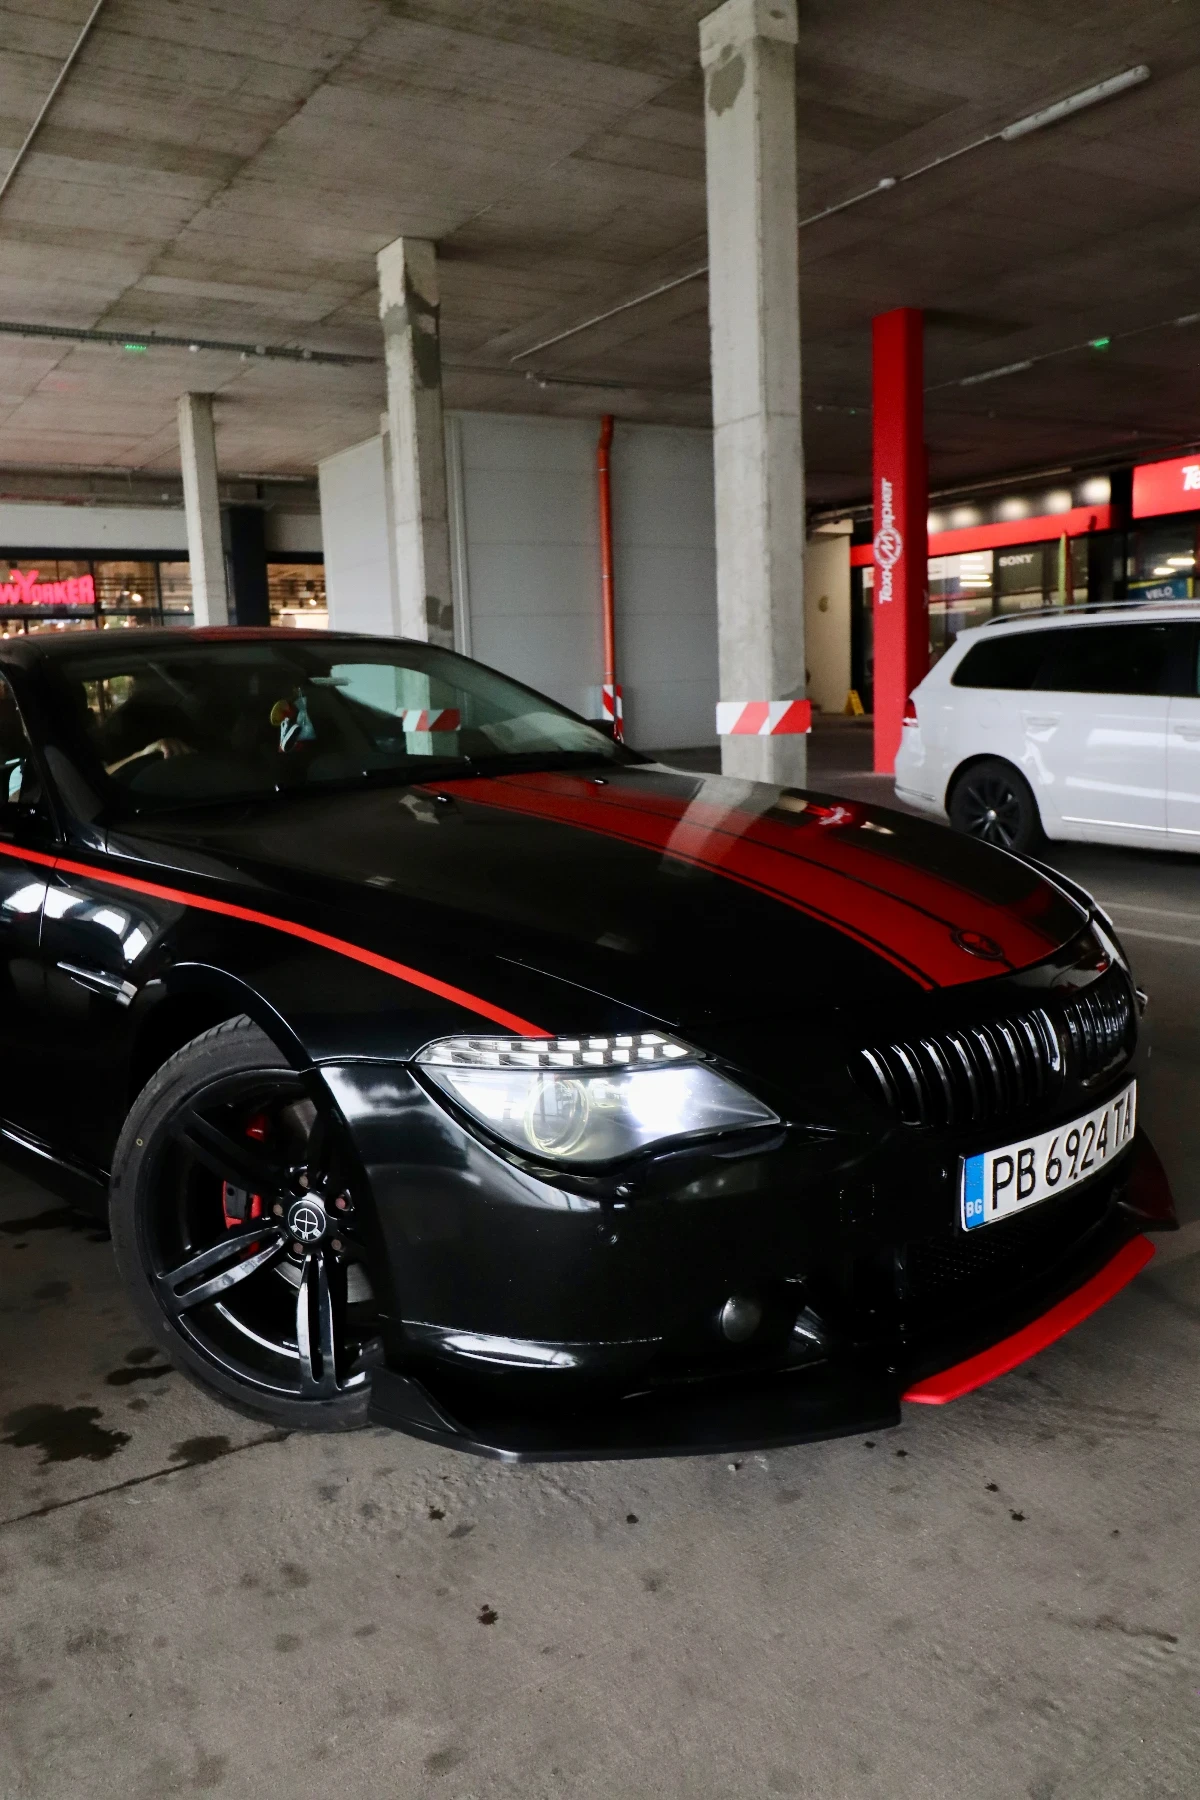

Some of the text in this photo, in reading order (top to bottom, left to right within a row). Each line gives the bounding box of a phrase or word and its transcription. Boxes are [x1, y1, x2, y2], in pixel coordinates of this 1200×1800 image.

[999, 554, 1034, 567] SONY
[1146, 586, 1173, 600] VELO
[992, 1091, 1131, 1210] PB 6924 TA
[966, 1199, 983, 1217] BG
